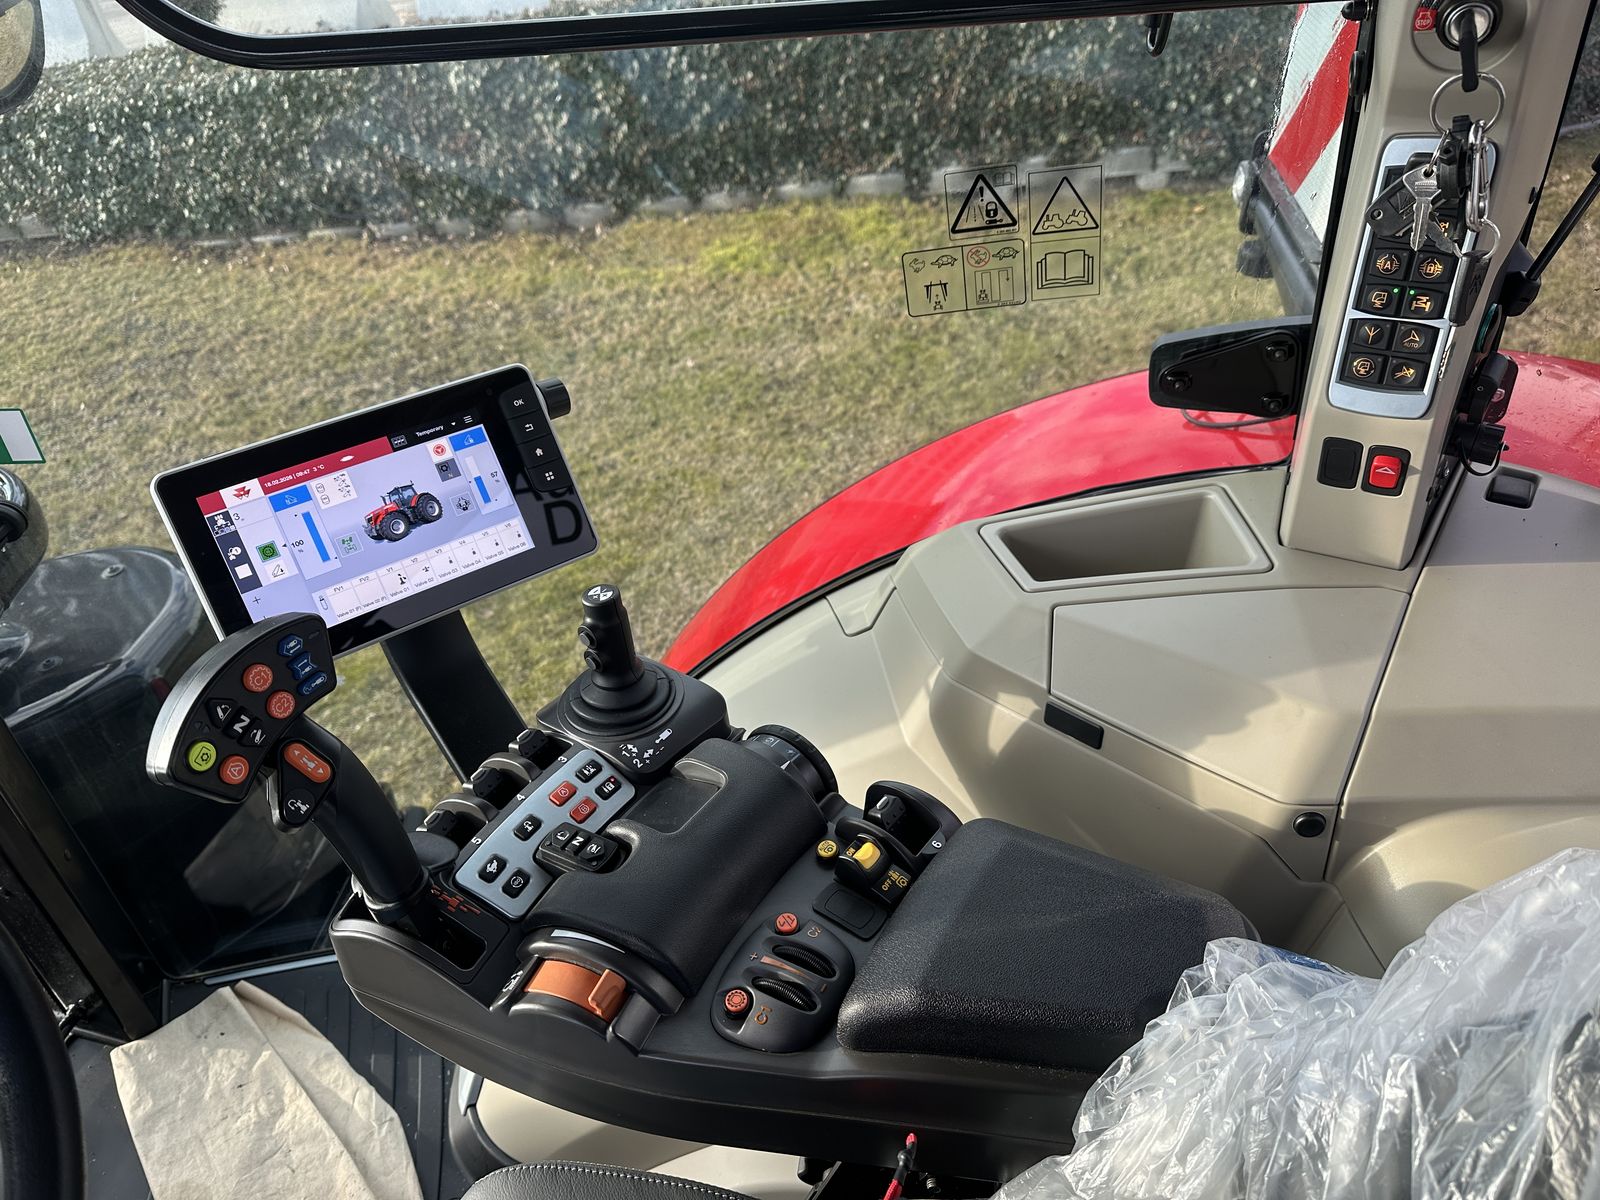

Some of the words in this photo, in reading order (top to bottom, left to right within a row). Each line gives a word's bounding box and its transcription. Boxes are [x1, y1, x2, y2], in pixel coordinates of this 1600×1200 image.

[513, 399, 525, 407] OK
[415, 424, 444, 438] Temporary
[291, 539, 304, 549] 100
[333, 585, 344, 593] FV1
[254, 671, 268, 686] C1
[275, 699, 290, 713] C2
[233, 714, 250, 734] N
[558, 756, 568, 764] 3
[633, 759, 643, 768] 2
[516, 793, 526, 802] 4
[471, 836, 482, 846] 5
[571, 836, 585, 846] N
[931, 839, 942, 849] 6
[846, 847, 856, 857] ON
[881, 879, 893, 891] OFF
